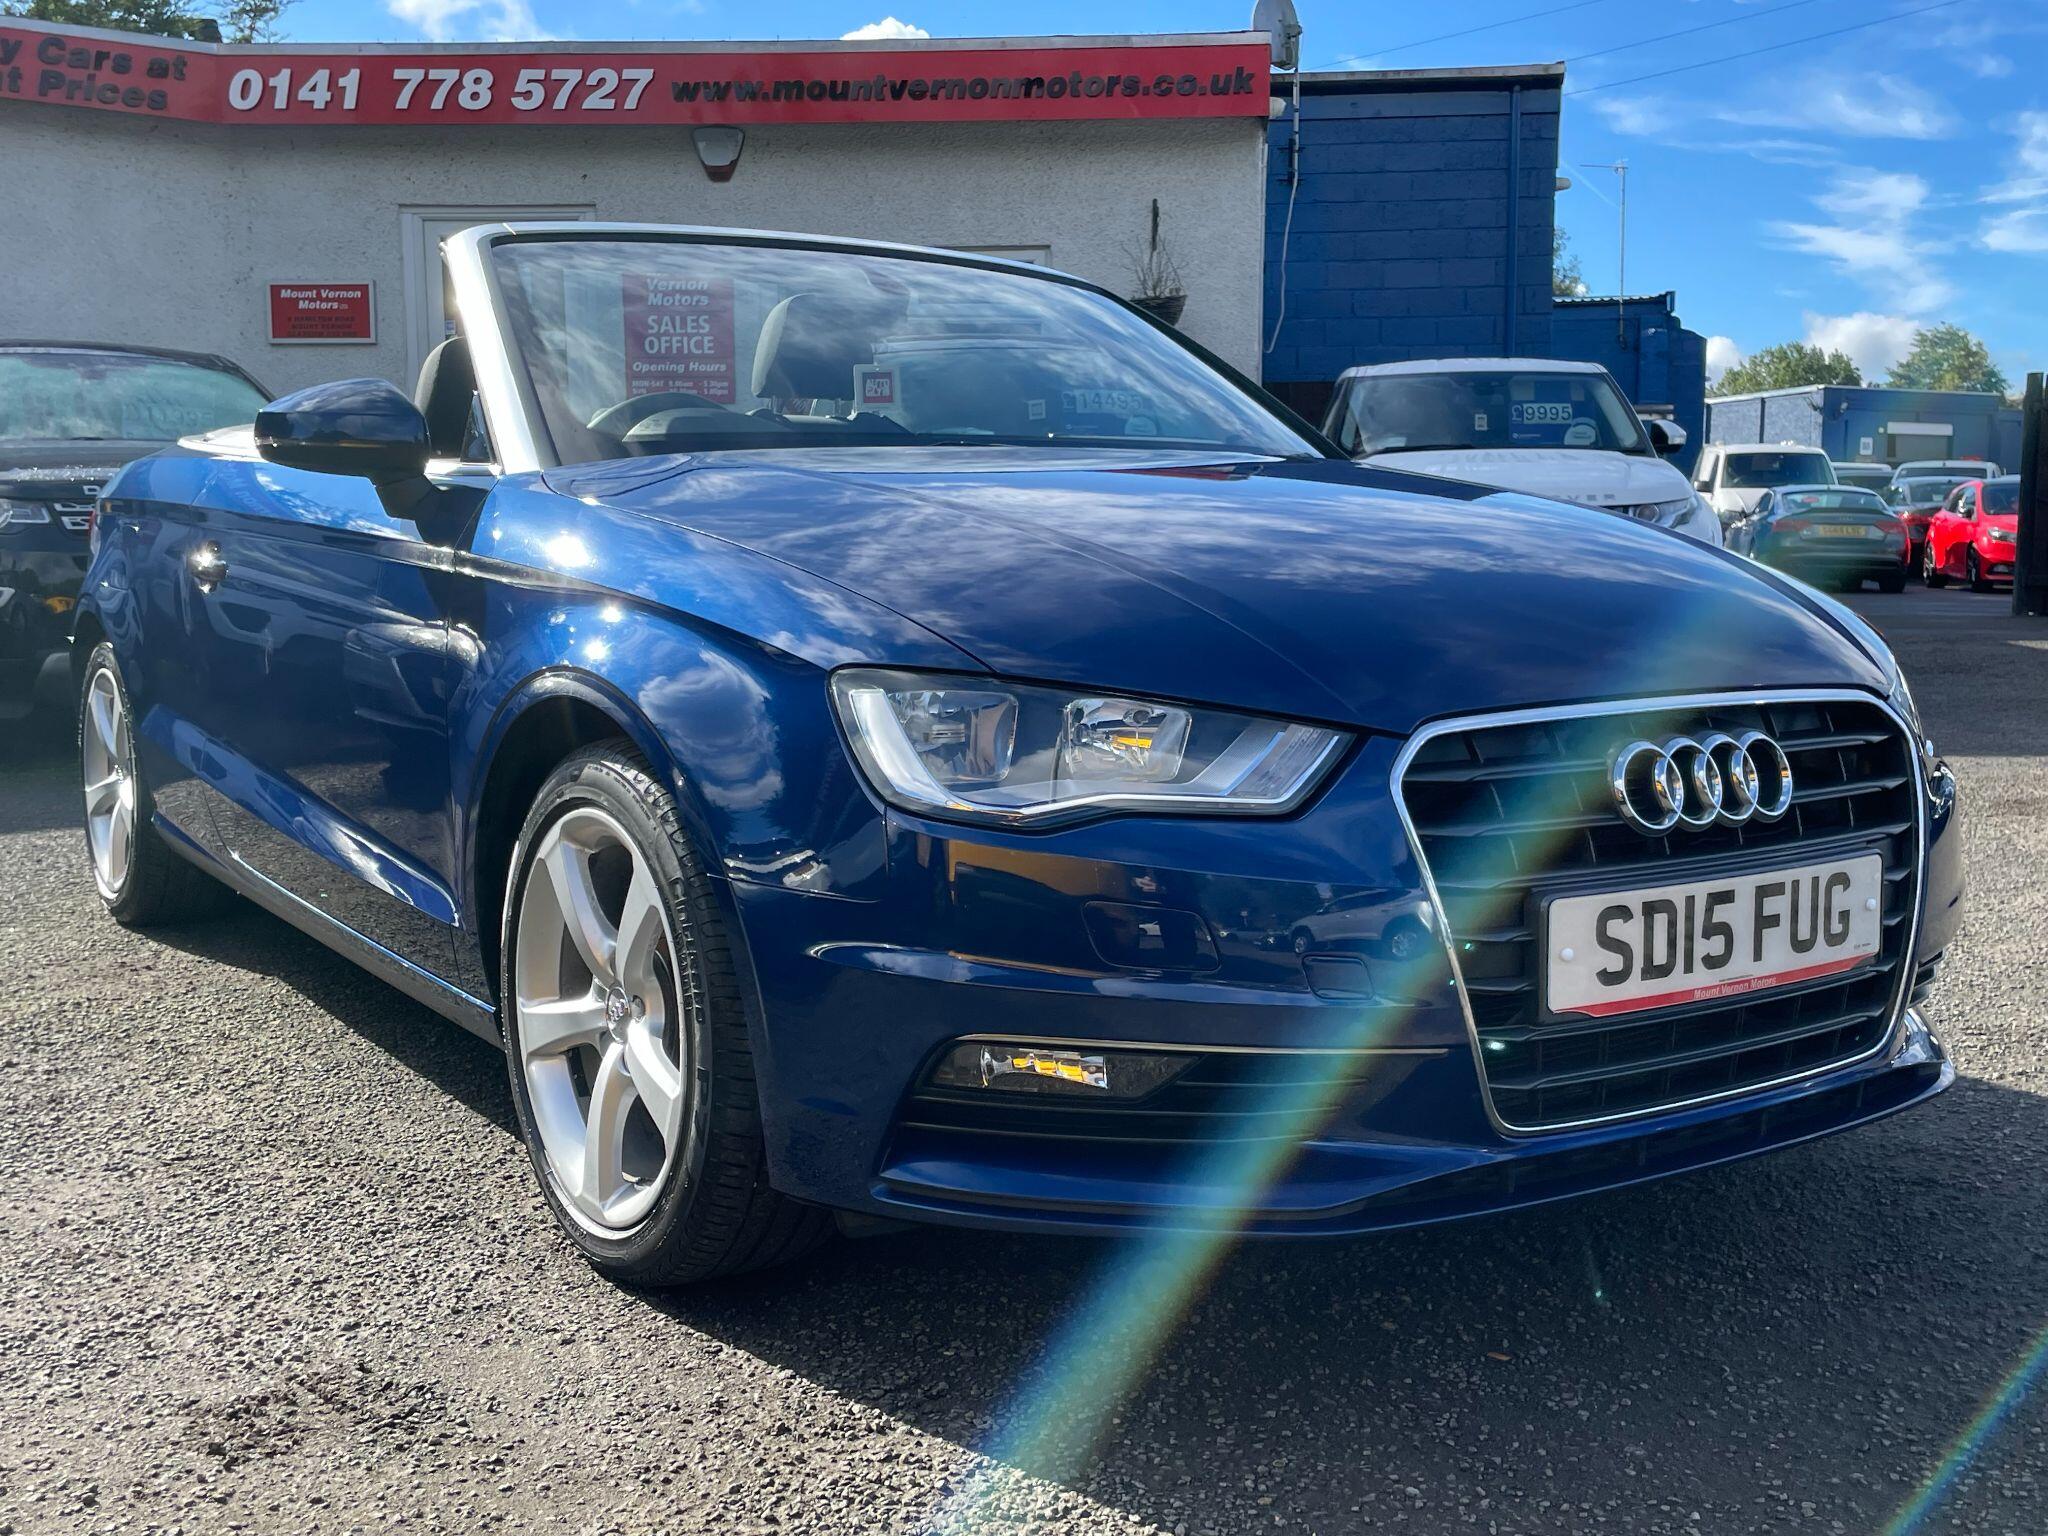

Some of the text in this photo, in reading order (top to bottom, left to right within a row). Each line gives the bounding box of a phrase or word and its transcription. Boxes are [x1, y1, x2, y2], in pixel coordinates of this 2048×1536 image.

[37, 35, 132, 75] Cars
[147, 54, 188, 81] at
[38, 68, 168, 111] Prices
[228, 68, 655, 111] 0141 778 5727
[671, 66, 1254, 103] www.mountvernonmotors.co.uk
[280, 288, 361, 299] Mount Vernon
[645, 278, 709, 291] Vernon
[298, 300, 339, 310] Motors
[647, 292, 709, 306] Motors
[647, 315, 710, 333] SALES
[643, 336, 715, 354] OFFICE
[632, 361, 727, 373] Opening Hours
[1596, 871, 1850, 987] SD15 FUG
[1693, 987, 1720, 1000] Mount
[1721, 982, 1749, 995] Vernon
[1750, 976, 1777, 989] Motors
